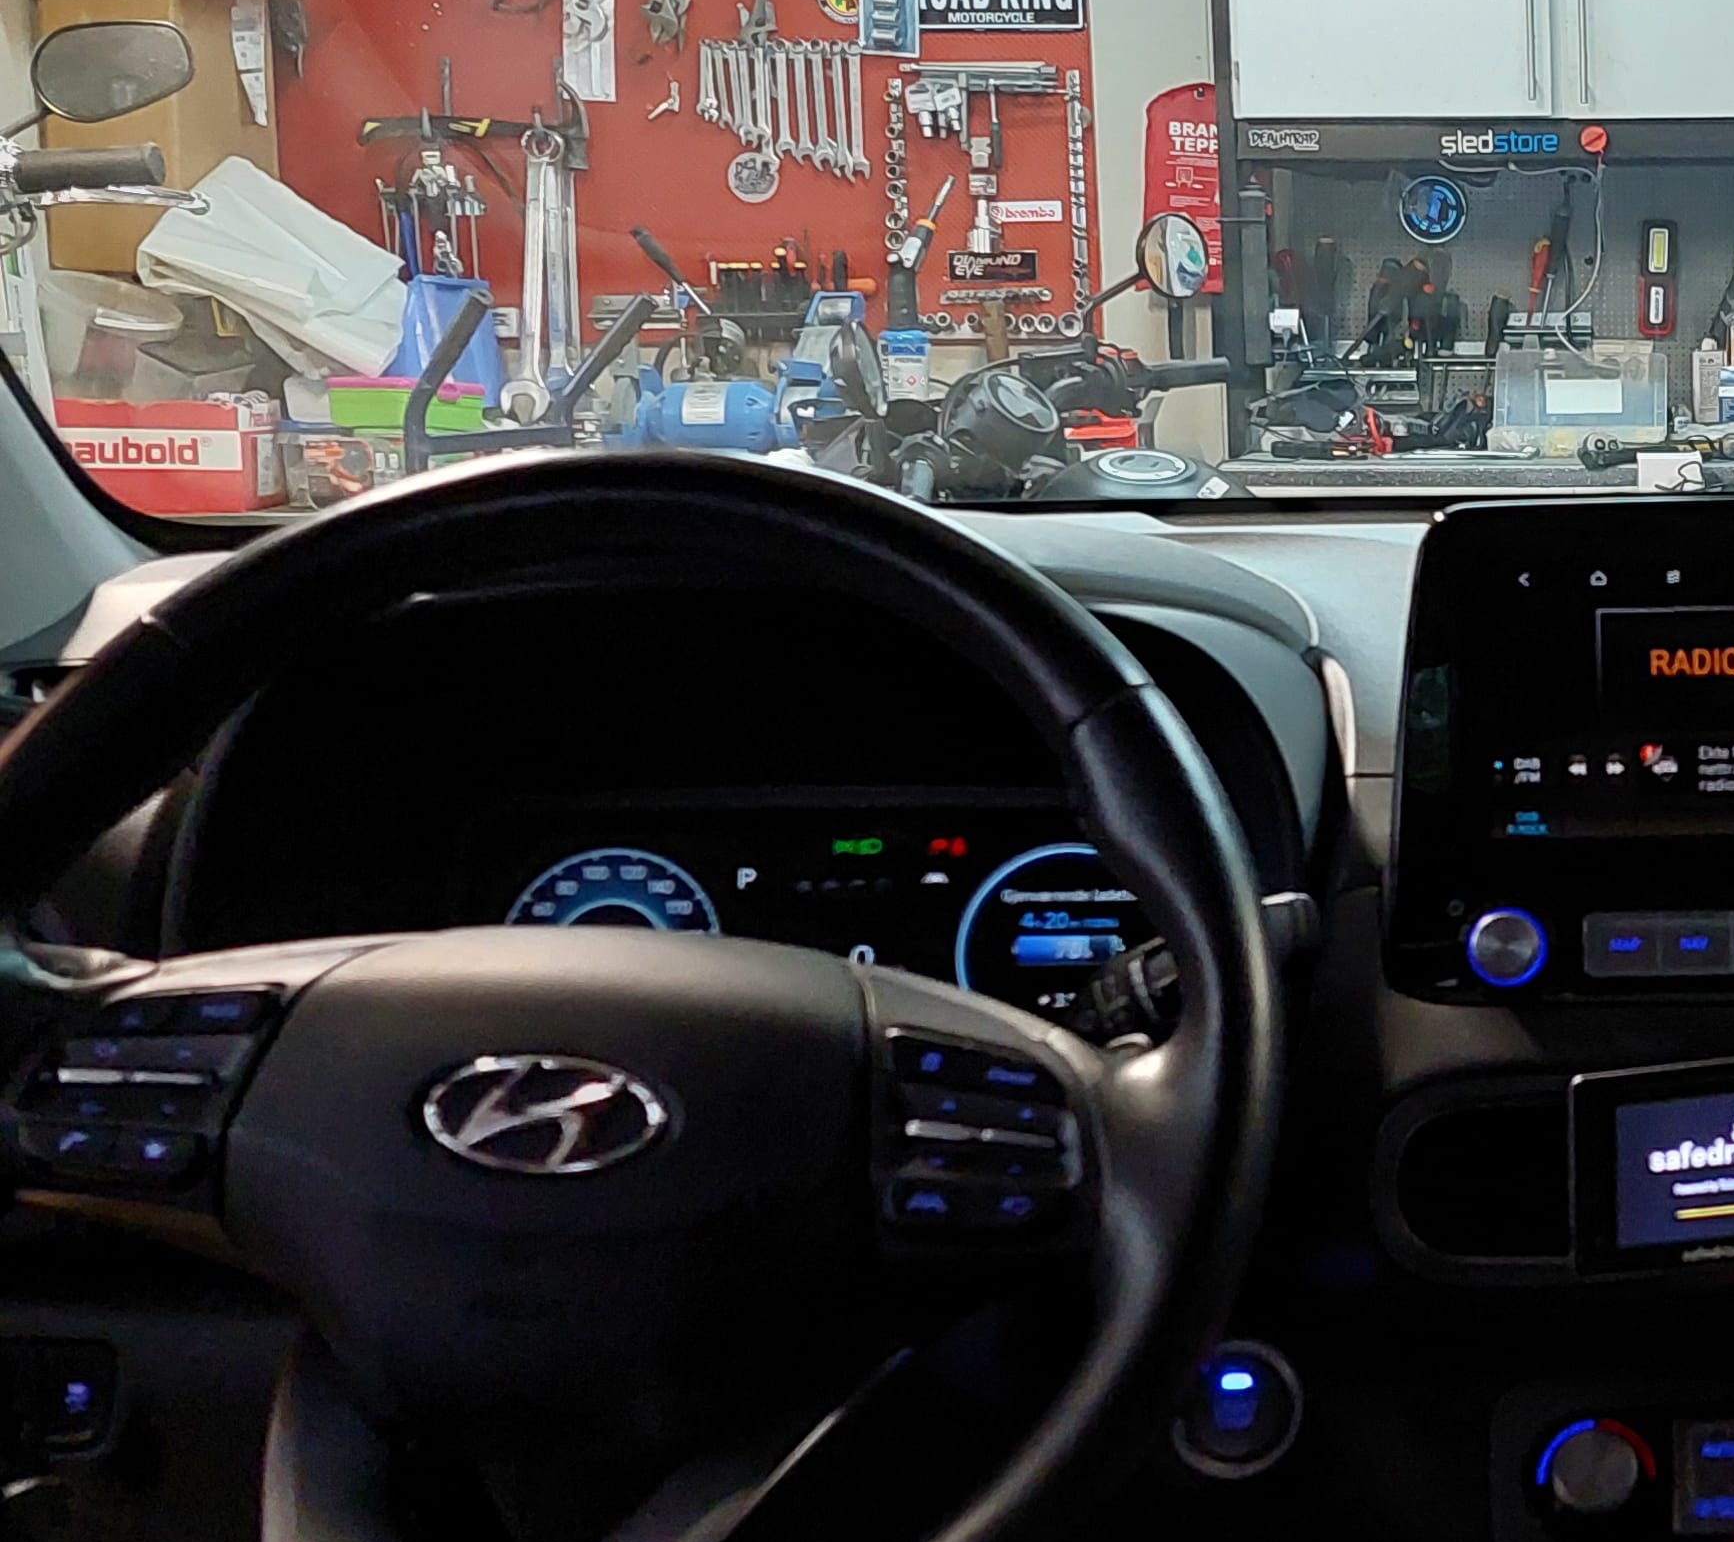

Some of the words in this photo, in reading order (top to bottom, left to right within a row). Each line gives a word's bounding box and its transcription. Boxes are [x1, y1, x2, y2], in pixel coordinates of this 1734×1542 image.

[948, 12, 1035, 24] MOTORCYCLE
[1440, 130, 1559, 156] sledstore
[1005, 206, 1057, 219] brembo
[953, 254, 1023, 267] DIAMOND
[955, 264, 986, 280] EYE
[736, 867, 758, 890] P
